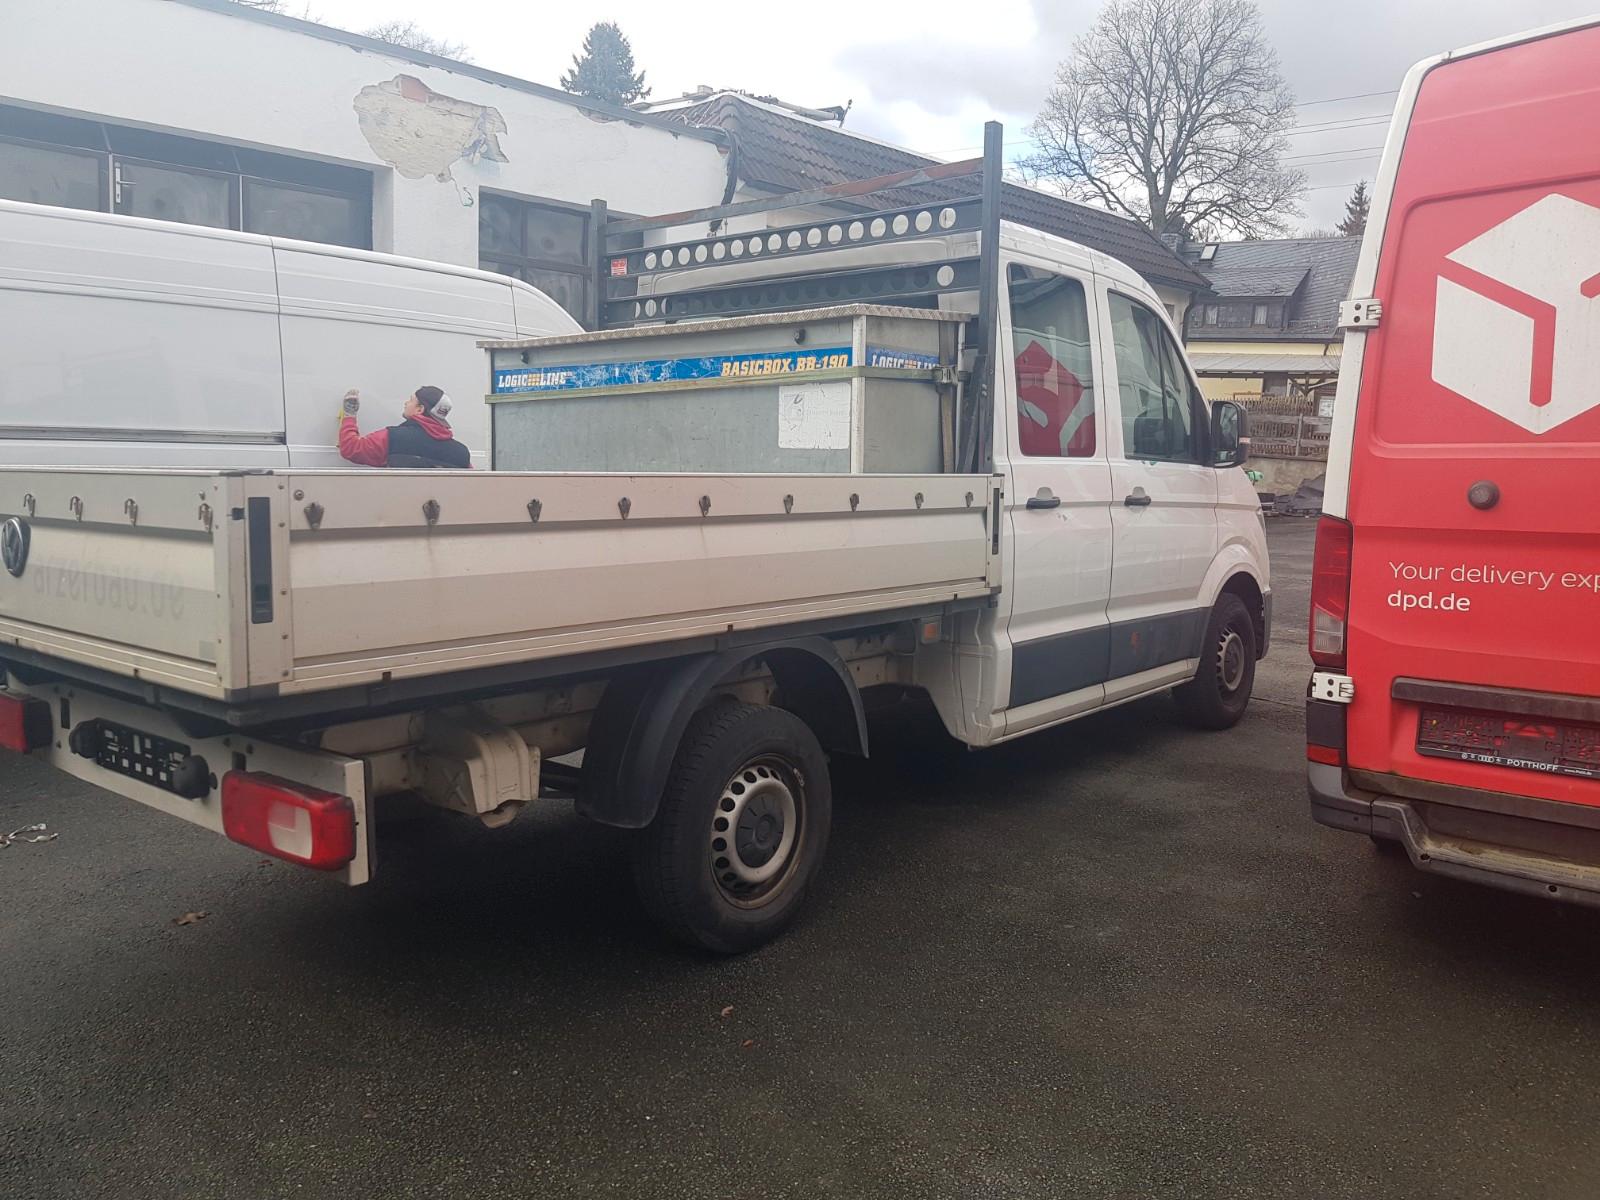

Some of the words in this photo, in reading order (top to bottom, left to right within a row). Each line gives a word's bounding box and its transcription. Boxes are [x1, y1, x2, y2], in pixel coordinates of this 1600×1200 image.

[795, 353, 848, 372] BB-190
[498, 374, 528, 388] LOGIC
[1388, 561, 1445, 581] Your
[1450, 564, 1555, 591] delivery
[1387, 590, 1471, 612] dpd.de
[1506, 758, 1559, 772] POTTHOFF
